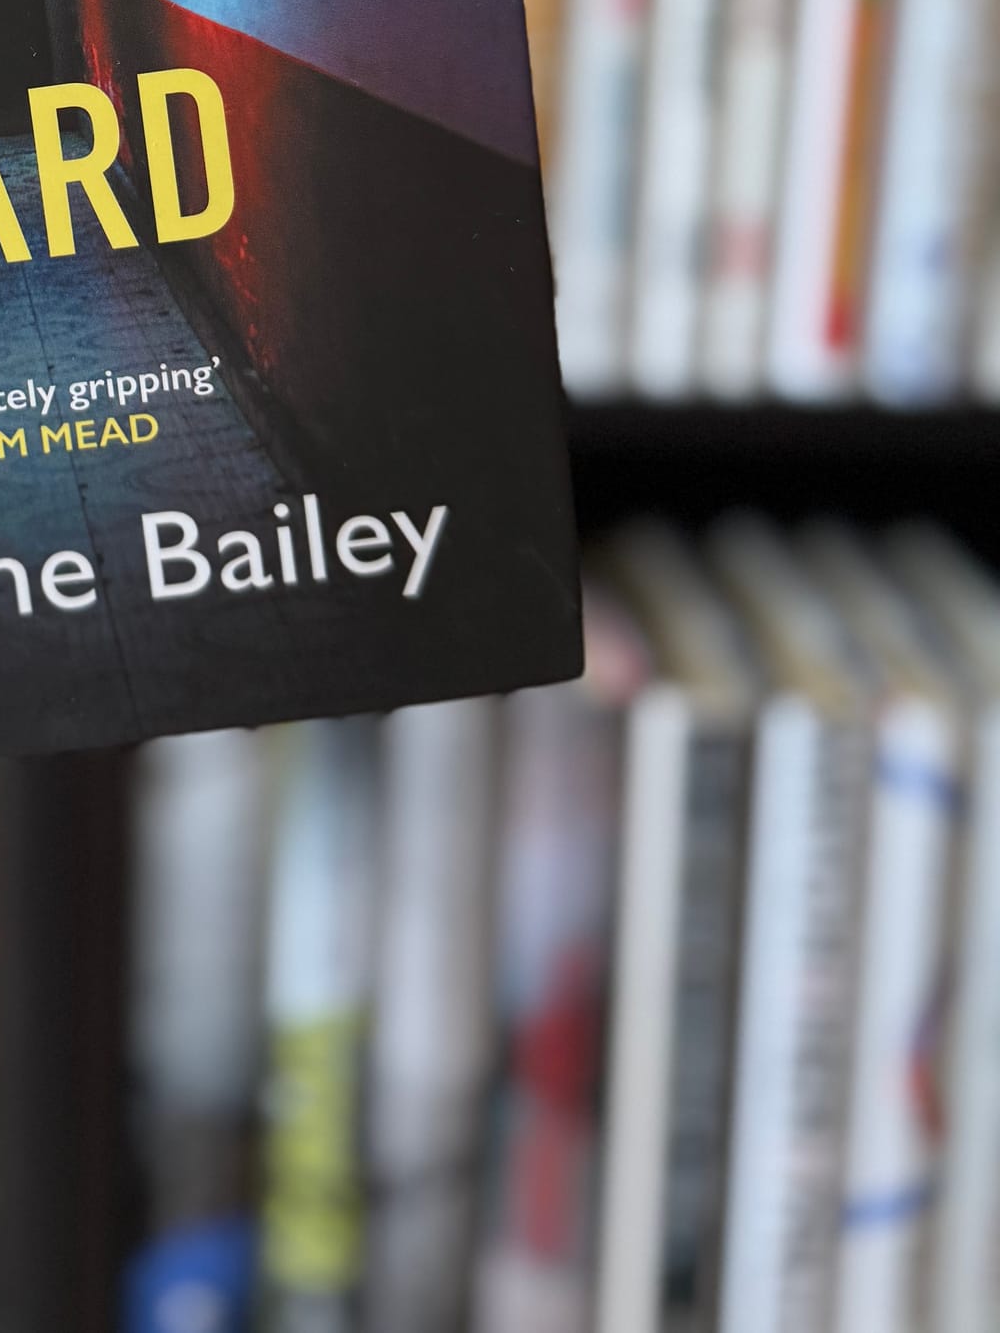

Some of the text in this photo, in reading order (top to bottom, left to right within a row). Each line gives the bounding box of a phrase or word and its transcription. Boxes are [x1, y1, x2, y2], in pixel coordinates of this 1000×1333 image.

[68, 356, 221, 410] gripping’
[39, 413, 160, 455] MEAD
[139, 493, 453, 602] Bailey
